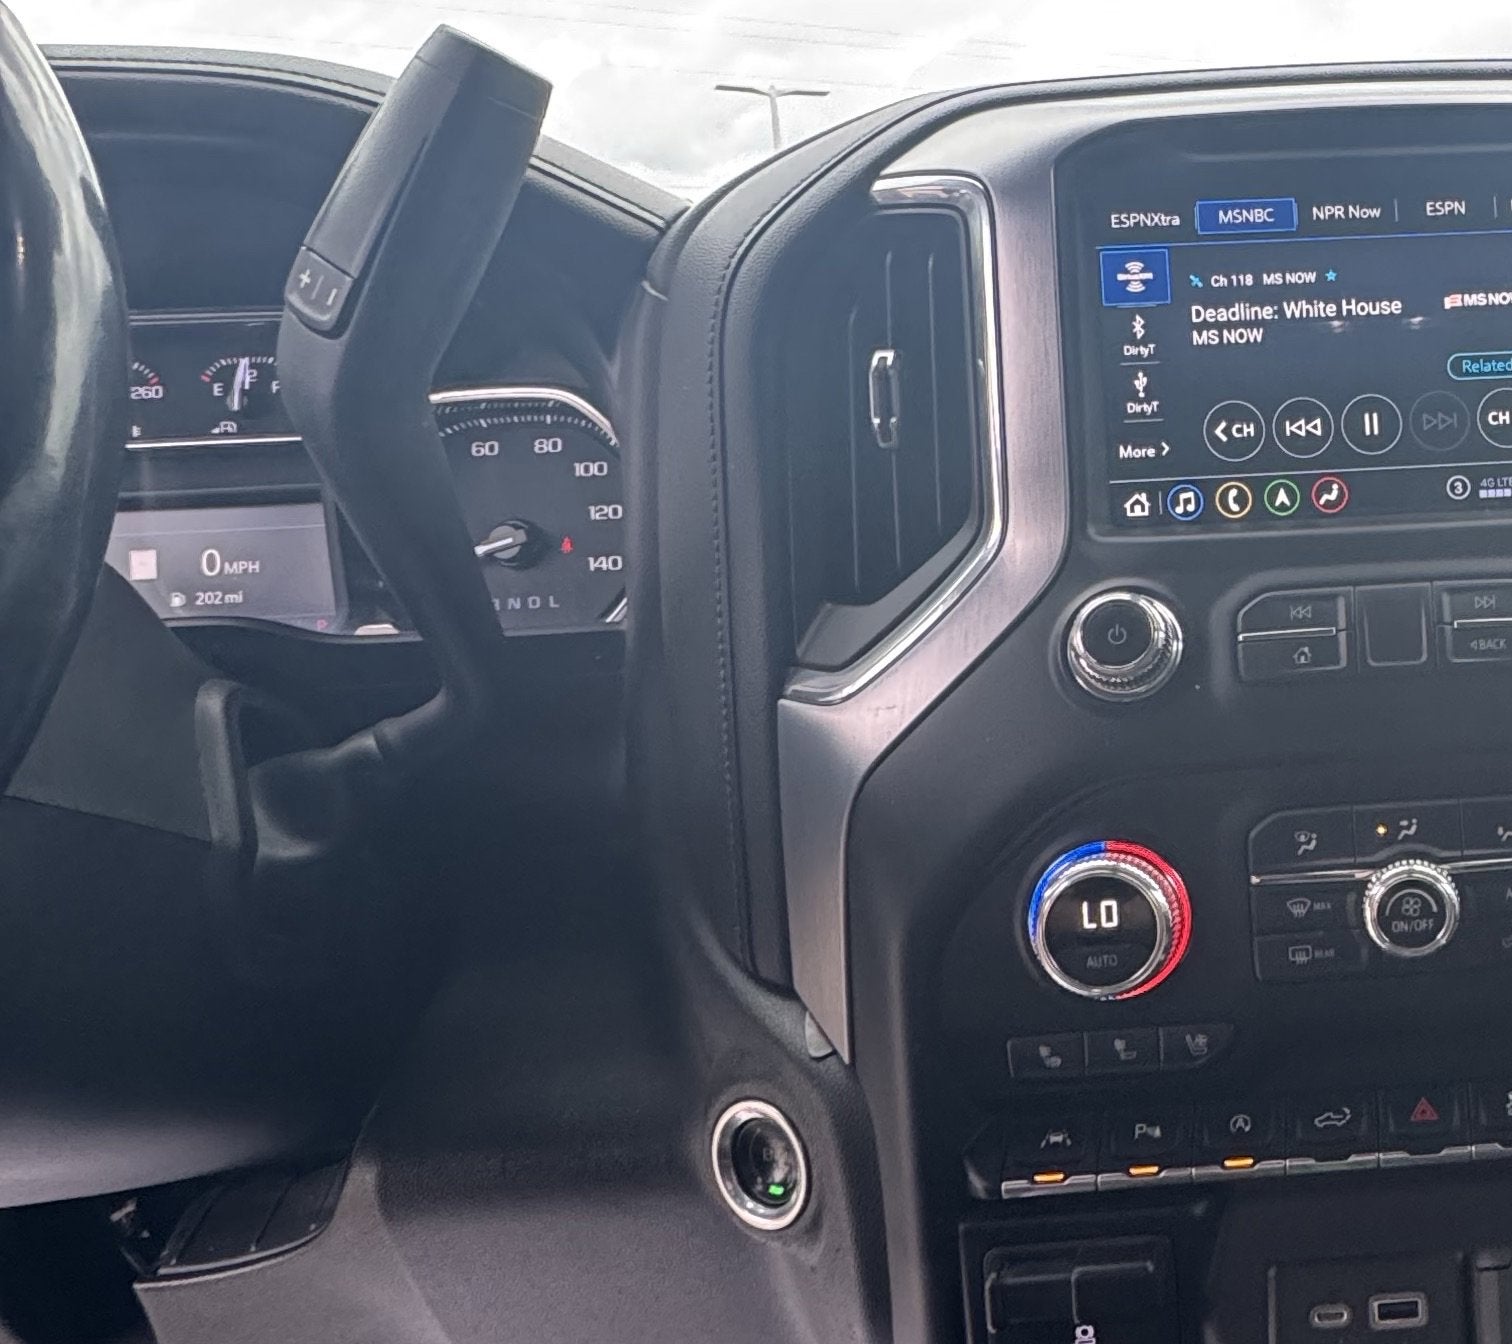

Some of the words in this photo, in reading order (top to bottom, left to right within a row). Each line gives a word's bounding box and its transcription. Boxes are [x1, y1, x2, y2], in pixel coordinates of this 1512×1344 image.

[1218, 207, 1275, 225] MSNBC
[1312, 205, 1346, 221] NPR
[1348, 204, 1382, 219] Now
[1425, 200, 1466, 216] ESPN
[1110, 212, 1181, 229] ESPNXtra
[1210, 275, 1228, 288] Ch
[1231, 274, 1254, 287] 118
[1262, 273, 1284, 286] MS
[1285, 271, 1317, 285] NOW
[1191, 303, 1279, 324] Deadline:
[1283, 300, 1337, 320] White
[1341, 297, 1403, 317] House
[1192, 329, 1220, 346] MS
[1222, 327, 1264, 344] NOW
[1123, 343, 1156, 358] DirtyT
[130, 385, 164, 400] 260
[212, 382, 224, 396] E
[1126, 400, 1160, 416] DirtyT
[1487, 410, 1511, 427] CH
[1231, 422, 1255, 438] CH
[471, 440, 500, 457] 60
[533, 437, 563, 454] 80
[1119, 444, 1156, 459] More
[573, 461, 609, 477] 100
[1480, 478, 1496, 488] 4G
[588, 504, 623, 520] 120
[201, 548, 222, 576] 0
[223, 560, 260, 575] MPH
[588, 555, 623, 571] 140
[195, 591, 223, 606] 202
[224, 590, 243, 604] mi
[1479, 638, 1507, 650] BACK
[1391, 919, 1434, 934] ON/OFF
[1086, 954, 1118, 968] AUTO
